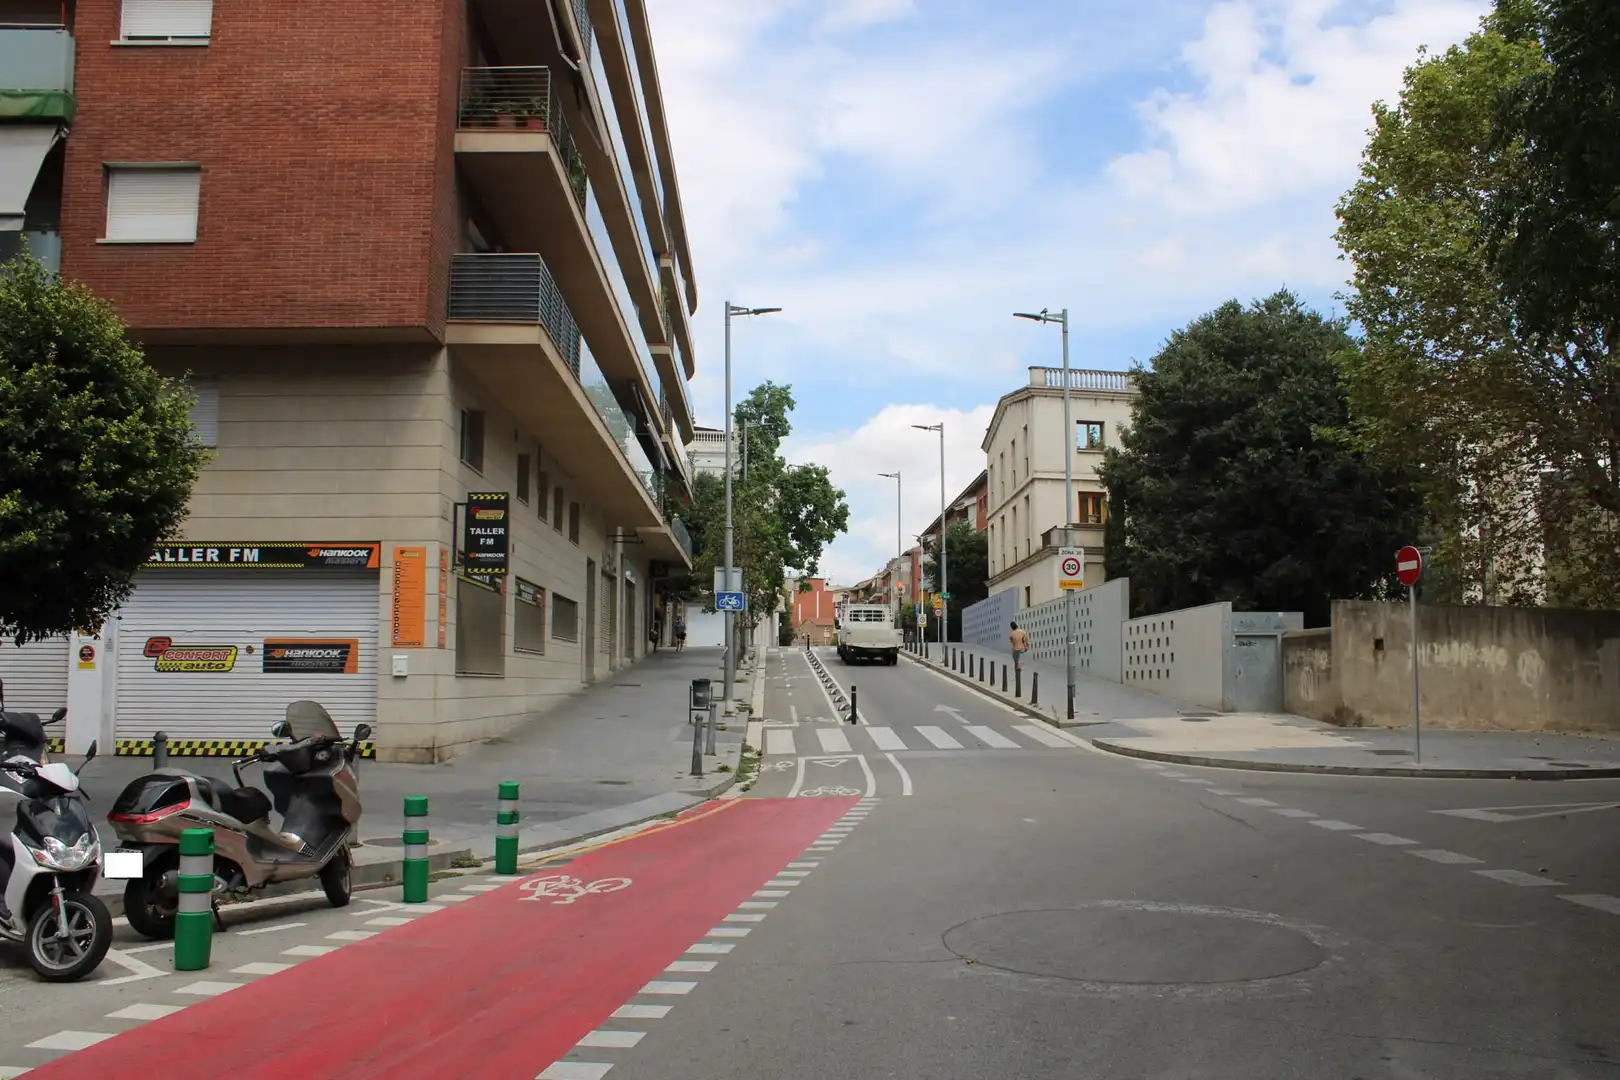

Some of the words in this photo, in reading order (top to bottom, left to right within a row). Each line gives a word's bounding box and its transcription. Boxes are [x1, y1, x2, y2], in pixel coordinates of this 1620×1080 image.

[470, 527, 505, 535] TALLER
[148, 548, 220, 562] ALLER
[229, 548, 259, 562] FM
[165, 650, 230, 661] CONFORT
[184, 661, 226, 670] auto
